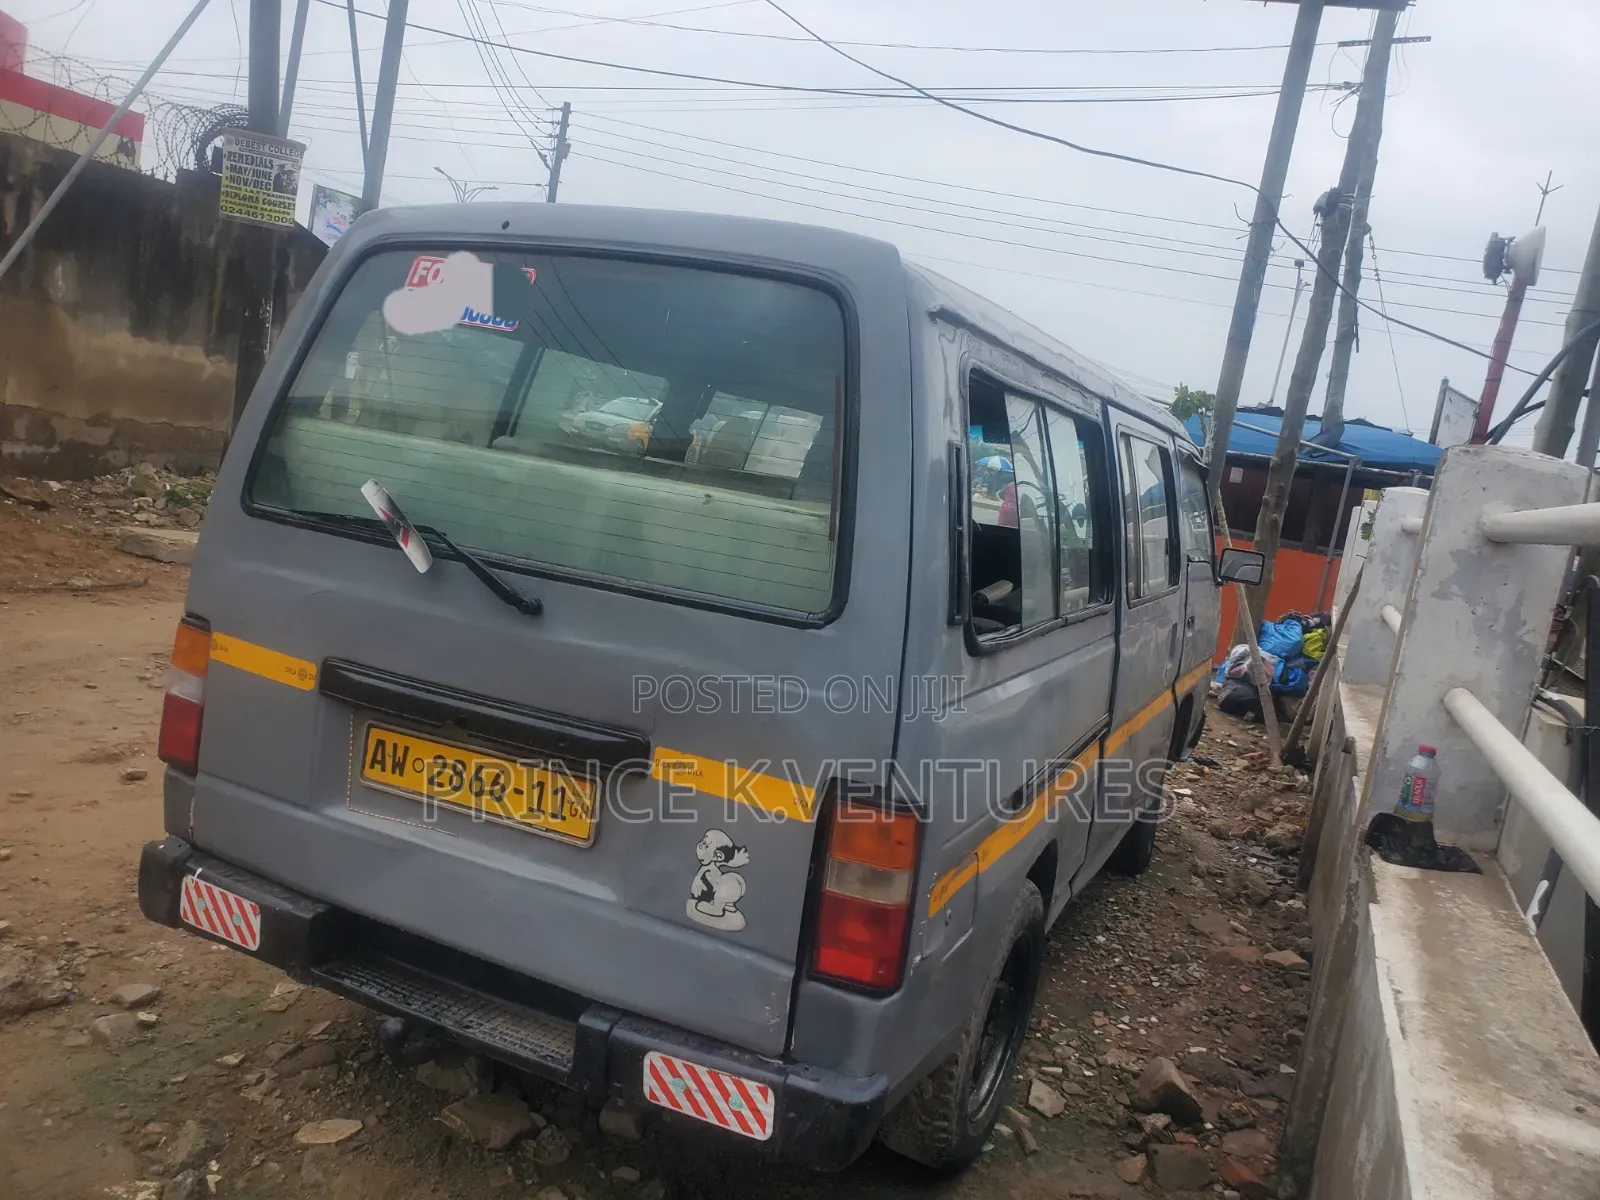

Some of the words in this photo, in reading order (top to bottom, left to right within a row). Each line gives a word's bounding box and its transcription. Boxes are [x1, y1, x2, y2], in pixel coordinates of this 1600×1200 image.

[234, 138, 267, 151] DEBEST
[268, 145, 304, 159] COLLEGE
[226, 151, 274, 171] REMEDIALS
[229, 163, 273, 181] MAY/JUNE
[229, 174, 272, 192] NOV/DEC
[223, 190, 260, 205] DIPLOMA
[261, 198, 296, 211] COURSES
[369, 738, 410, 778] AW
